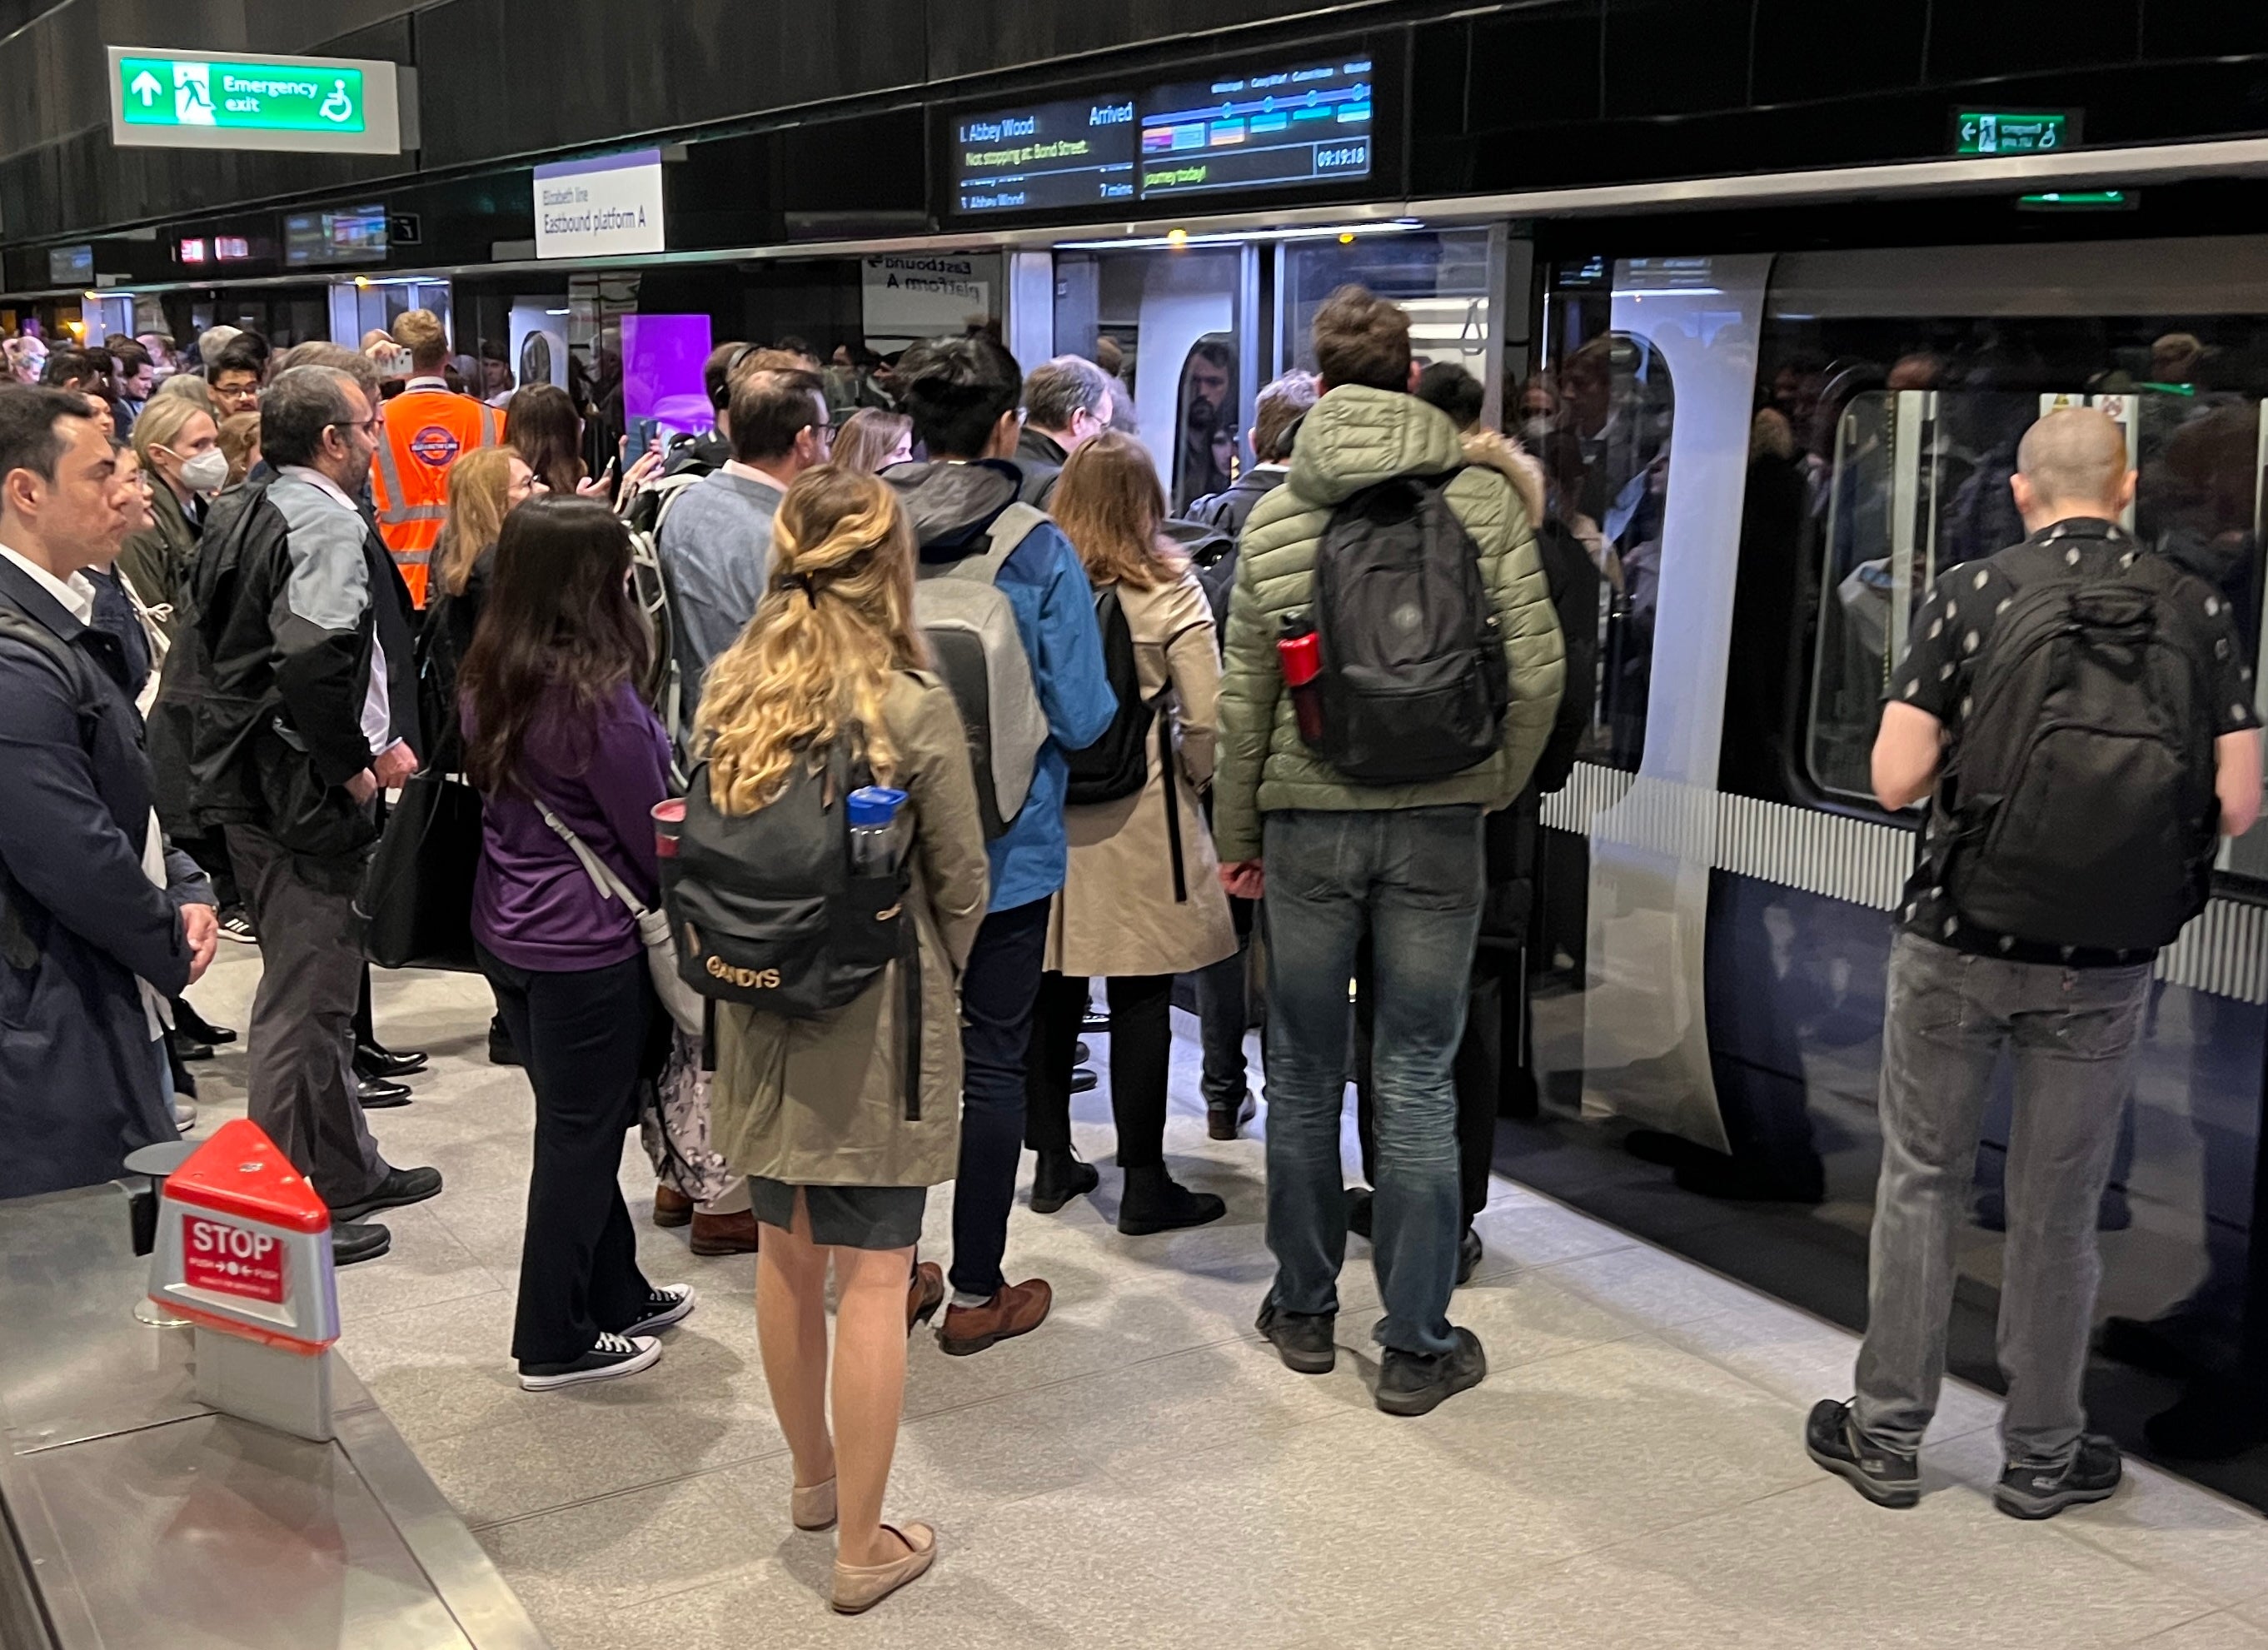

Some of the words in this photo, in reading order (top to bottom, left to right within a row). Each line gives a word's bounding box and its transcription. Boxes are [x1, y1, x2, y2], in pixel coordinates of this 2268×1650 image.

[223, 76, 318, 98] Emergency
[225, 97, 261, 113] exit
[969, 122, 999, 142] Abbey
[1001, 117, 1034, 137] Wood
[1089, 101, 1133, 126] Arrived
[965, 152, 983, 166] Not
[984, 149, 1021, 166] stopping
[1034, 142, 1057, 158] Bond
[545, 210, 591, 234] Eastbound
[593, 207, 636, 237] platform
[638, 204, 646, 227] A
[192, 1221, 274, 1260] STOP
